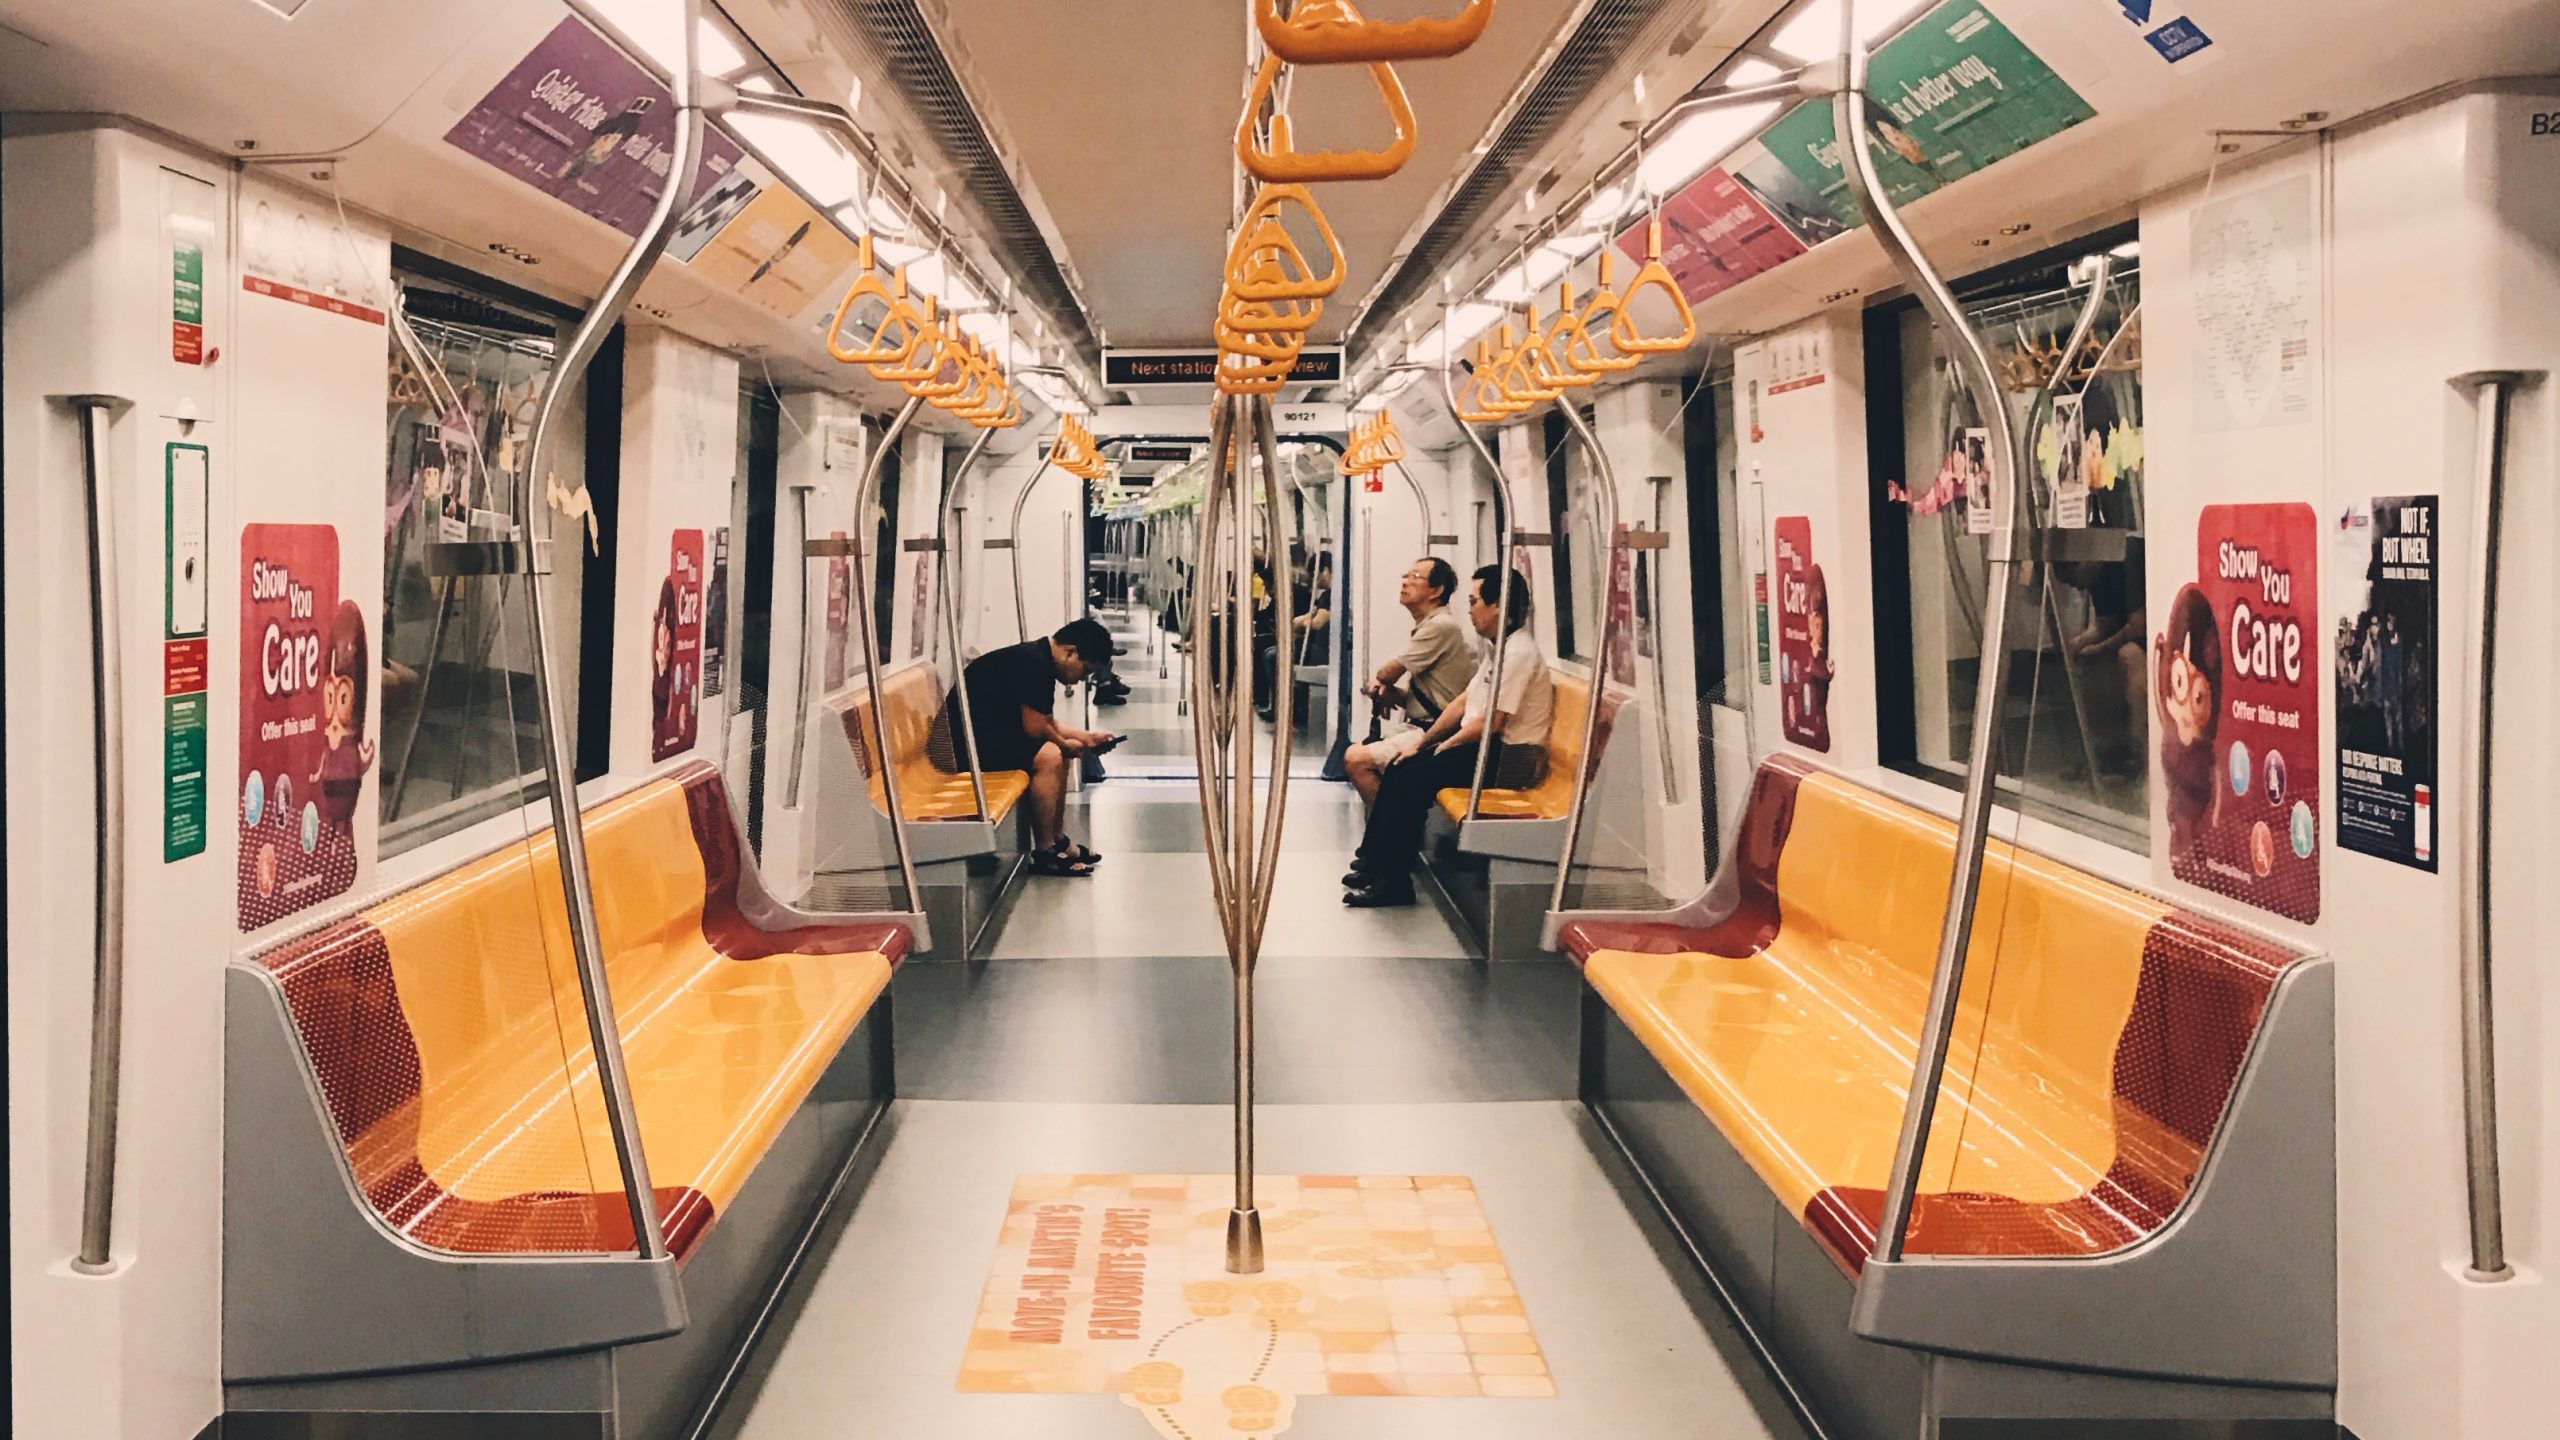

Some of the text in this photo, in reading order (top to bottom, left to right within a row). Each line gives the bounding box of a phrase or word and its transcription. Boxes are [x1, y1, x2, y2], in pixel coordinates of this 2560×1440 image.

[1898, 72, 1959, 112] better
[1947, 54, 2004, 90] way.
[1131, 361, 1166, 376] Next
[1170, 362, 1217, 376] statio
[1284, 411, 1317, 422] 90121
[2400, 507, 2419, 534] NOT
[2218, 541, 2290, 604] Show You
[2382, 537, 2400, 564] BUT
[252, 561, 313, 619] Show You
[262, 622, 320, 696] Care
[2230, 603, 2301, 682] Care
[261, 714, 317, 742] Offer this seat
[2231, 699, 2300, 729] Offer this seat
[1008, 1204, 1084, 1345] MOVE-IN MARTIN'S
[1086, 1208, 1152, 1341] FAVOURITE SPOT!
